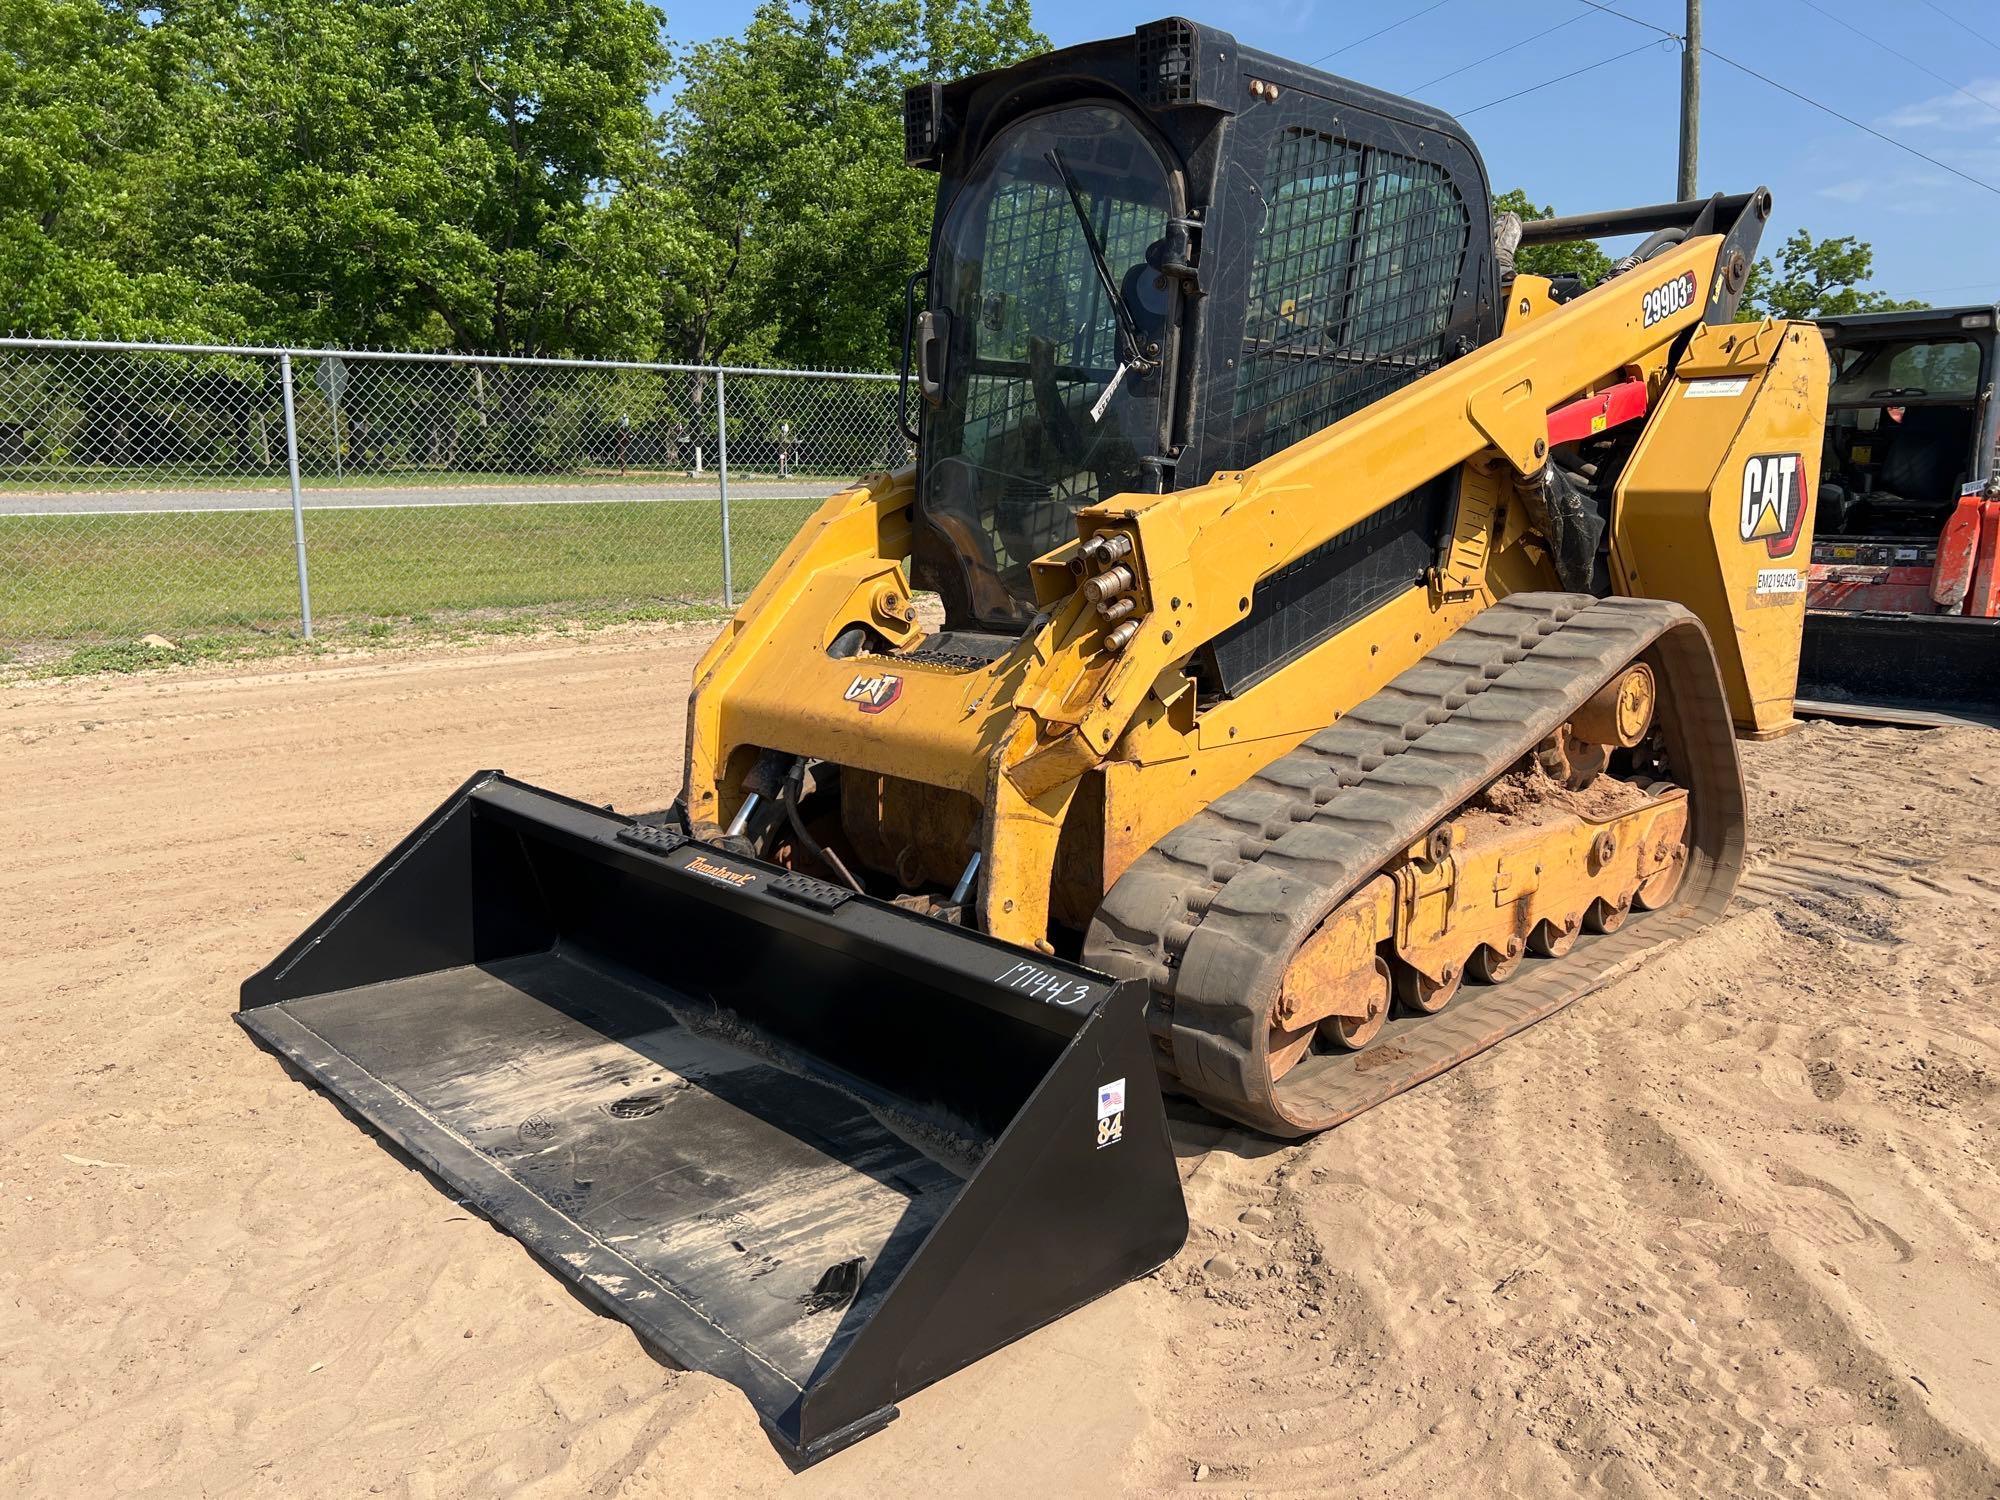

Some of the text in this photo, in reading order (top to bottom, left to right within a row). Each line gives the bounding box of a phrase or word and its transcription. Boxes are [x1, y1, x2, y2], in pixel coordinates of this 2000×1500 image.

[1643, 275, 1687, 328] 299D3
[1740, 456, 1797, 540] CAT
[1757, 572, 1797, 590] EM2192426
[844, 672, 898, 706] CAT
[684, 856, 756, 885] Tomahawk
[994, 961, 1090, 1006] 171443
[1097, 1112, 1123, 1145] 84
